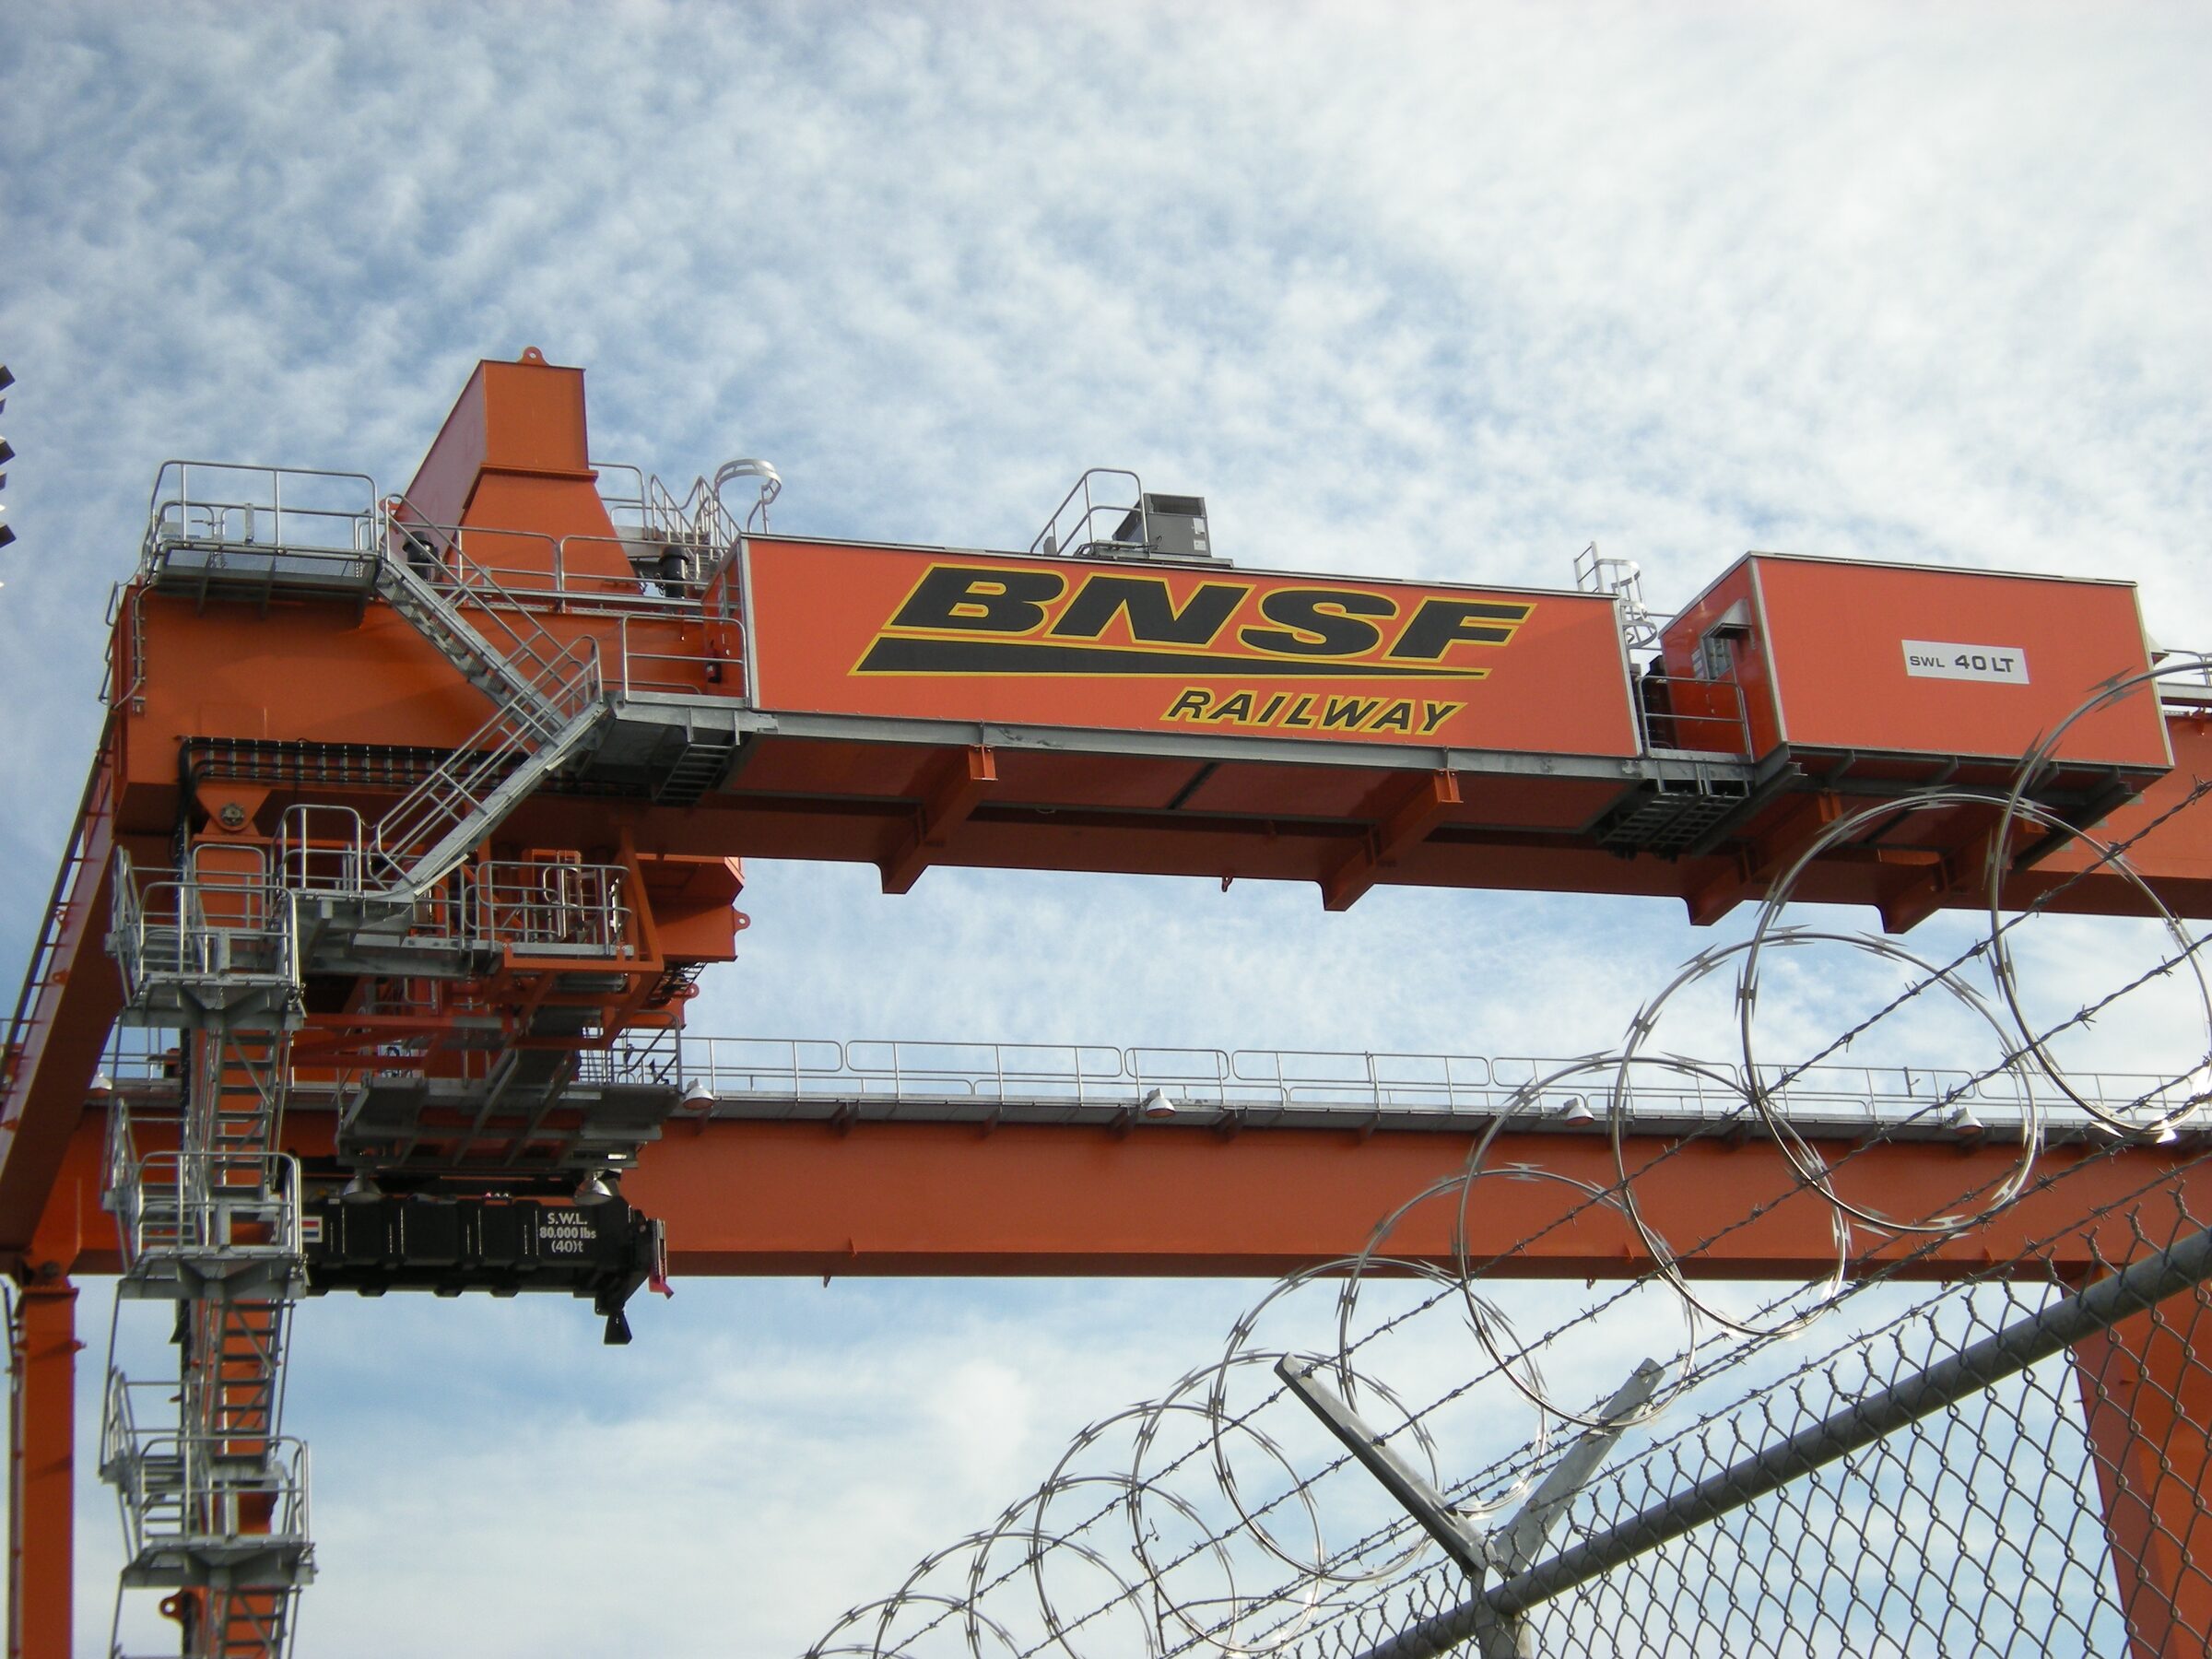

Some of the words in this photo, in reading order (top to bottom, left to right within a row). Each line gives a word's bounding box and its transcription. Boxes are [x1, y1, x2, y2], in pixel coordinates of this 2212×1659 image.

[882, 563, 1537, 663] BNSF
[1910, 655, 1946, 668] SWL
[1955, 654, 1987, 671] 40
[1992, 657, 2014, 673] LT
[1160, 687, 1468, 735] RAILWAY
[547, 1212, 588, 1225] S.W.L.
[580, 1227, 596, 1239] lbs
